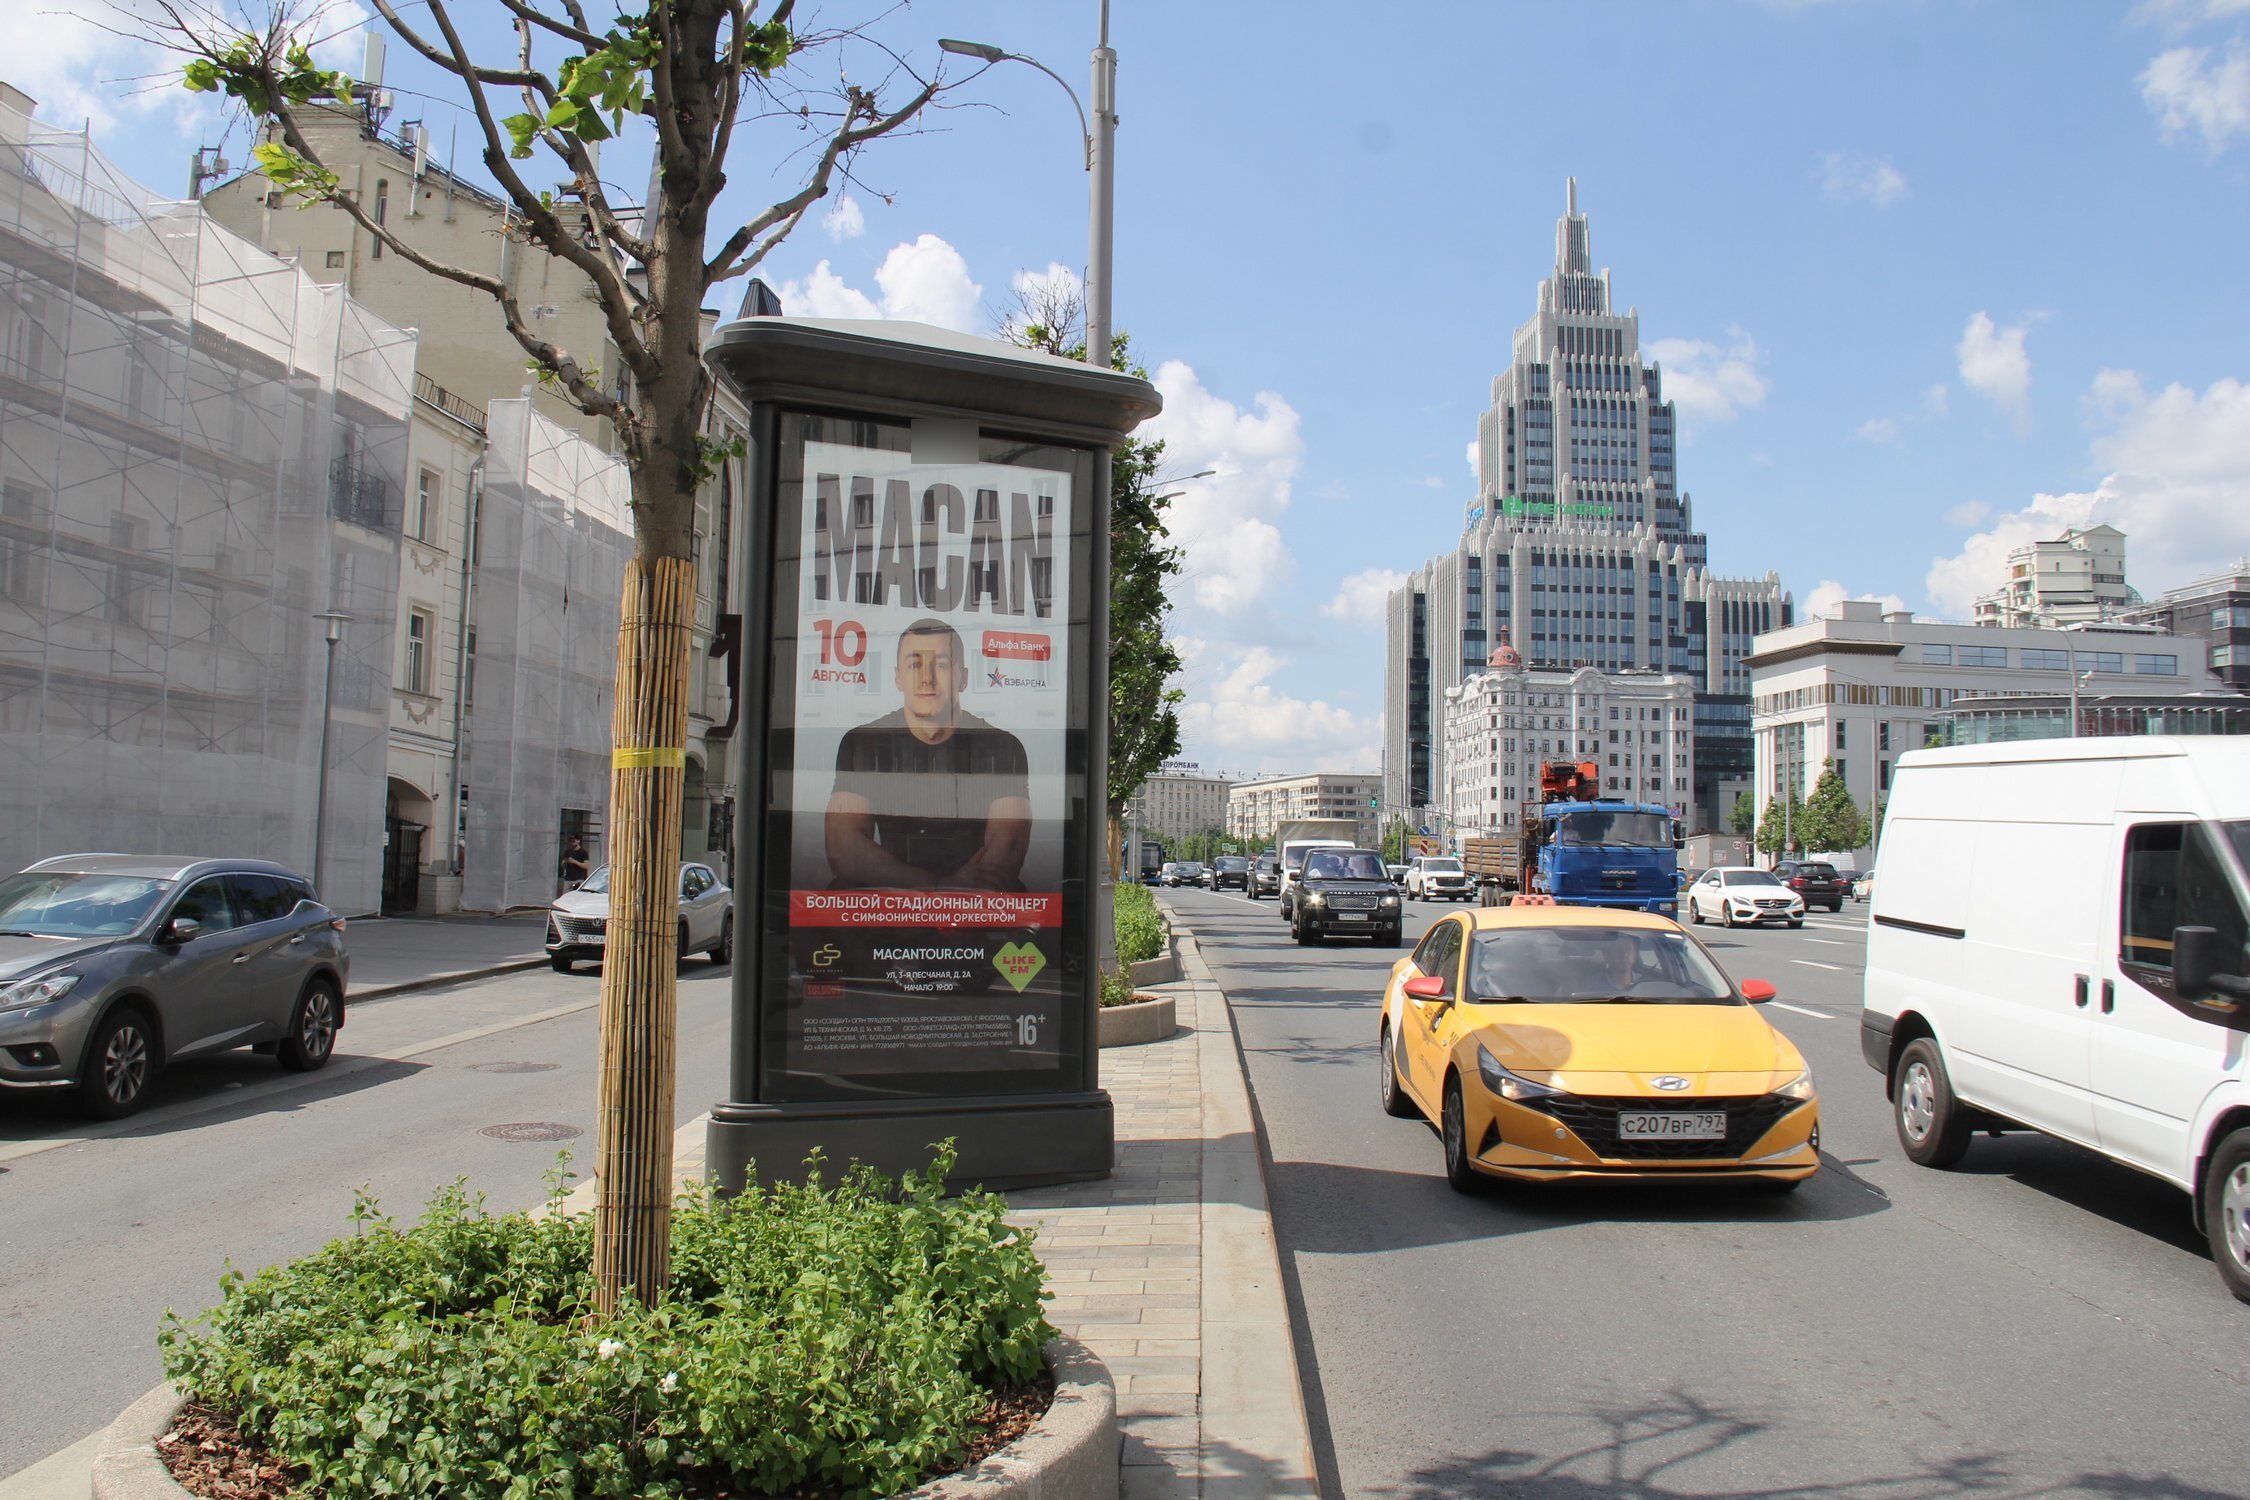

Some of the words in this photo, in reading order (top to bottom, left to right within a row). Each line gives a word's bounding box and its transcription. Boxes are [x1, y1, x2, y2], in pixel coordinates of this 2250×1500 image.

[815, 472, 1053, 618] MACAN
[812, 619, 867, 667] 10
[988, 638, 1019, 652] Альфа
[1020, 641, 1045, 652] Банк
[811, 669, 867, 684] АВГУСТА
[1004, 678, 1047, 688] ВЭБАРЕНА
[806, 895, 880, 909] БОЛЬШОЙ
[885, 895, 983, 911] СТАДИОННЫЙ
[987, 897, 1048, 911] КОНЦЕРТ
[841, 913, 849, 922] С
[852, 912, 950, 922] СИМФОНИЧЕСКИМ
[953, 913, 1016, 922] ОРКЕСТРОМ
[873, 948, 984, 960] MACANTOUR.COM
[1002, 956, 1036, 965] LIKE
[886, 971, 898, 979] УЛ.
[912, 971, 952, 979] ПЕСЧАНАЯ,
[953, 971, 961, 979] Д.
[1010, 966, 1030, 974] FM
[936, 983, 953, 991] 19:00
[1016, 1013, 1046, 1046] 16+
[1625, 1116, 1692, 1133] С207ВР
[1697, 1115, 1722, 1128] 797
